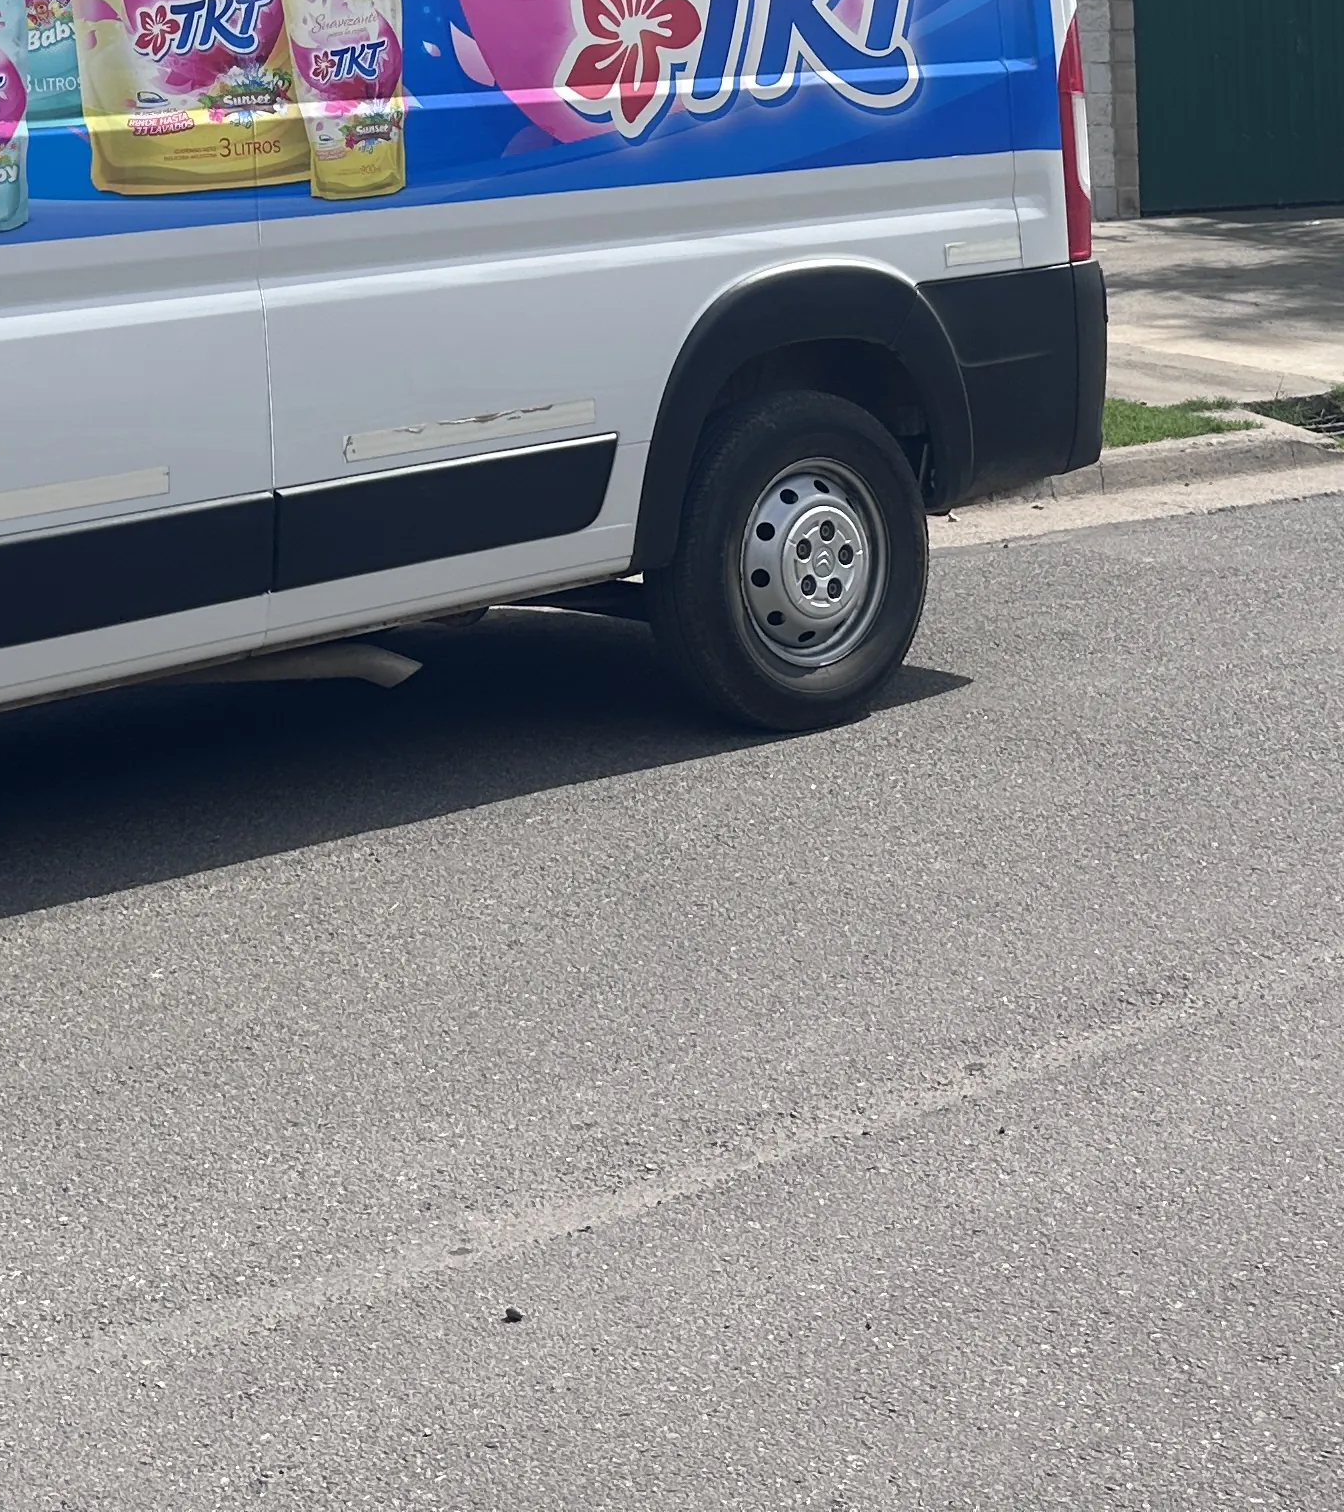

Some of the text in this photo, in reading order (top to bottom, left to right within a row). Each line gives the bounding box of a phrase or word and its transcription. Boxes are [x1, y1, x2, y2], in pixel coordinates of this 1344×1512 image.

[312, 10, 379, 34] Suavizante
[330, 40, 386, 79] TKT
[223, 94, 271, 106] Sunset
[219, 138, 231, 157] 3
[234, 140, 281, 156] LITROS
